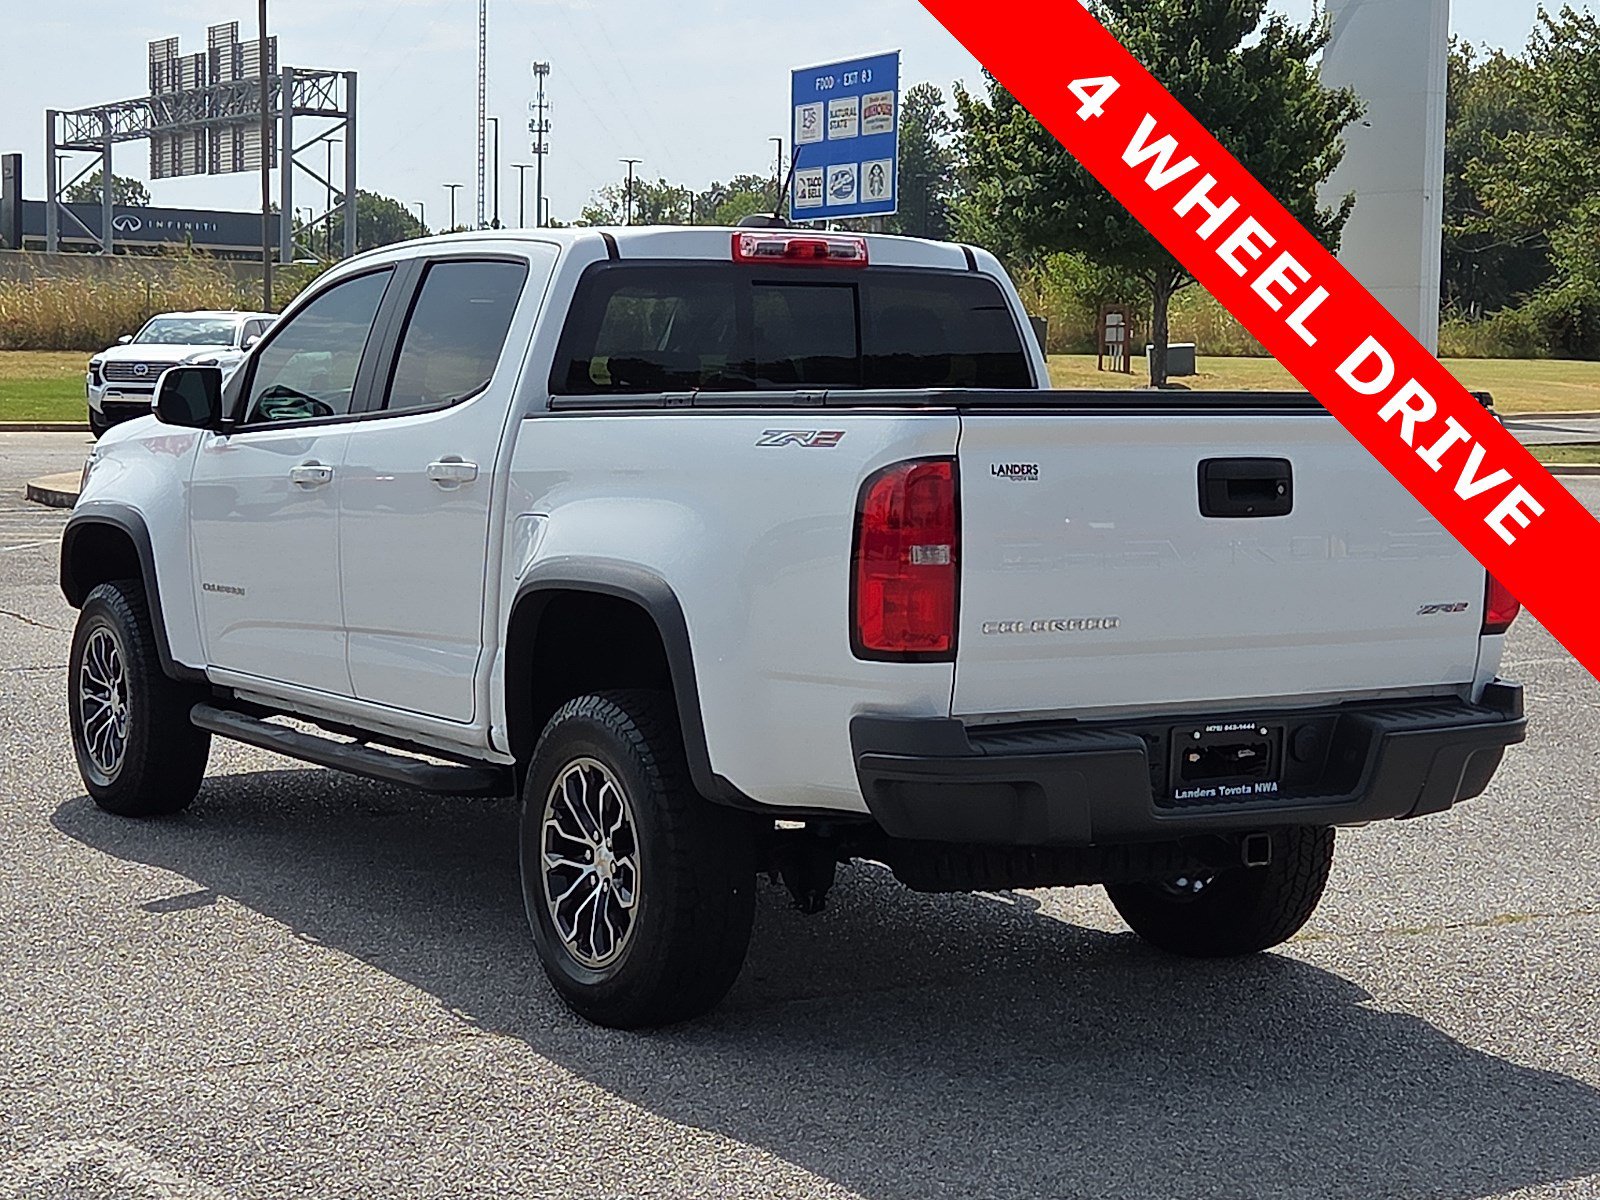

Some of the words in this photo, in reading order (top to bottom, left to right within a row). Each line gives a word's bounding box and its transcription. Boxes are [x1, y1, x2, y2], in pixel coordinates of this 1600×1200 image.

[815, 75, 834, 90] FOOD
[843, 71, 858, 86] EXIT
[829, 118, 848, 130] STATE
[806, 176, 822, 187] TACO
[807, 187, 822, 199] BELL
[148, 219, 217, 232] INFINITI
[755, 429, 846, 448] ZR2
[991, 463, 1039, 476] LANDERS
[1175, 787, 1216, 799] Landers
[1218, 784, 1252, 796] Toyota
[1254, 781, 1278, 793] NWA
